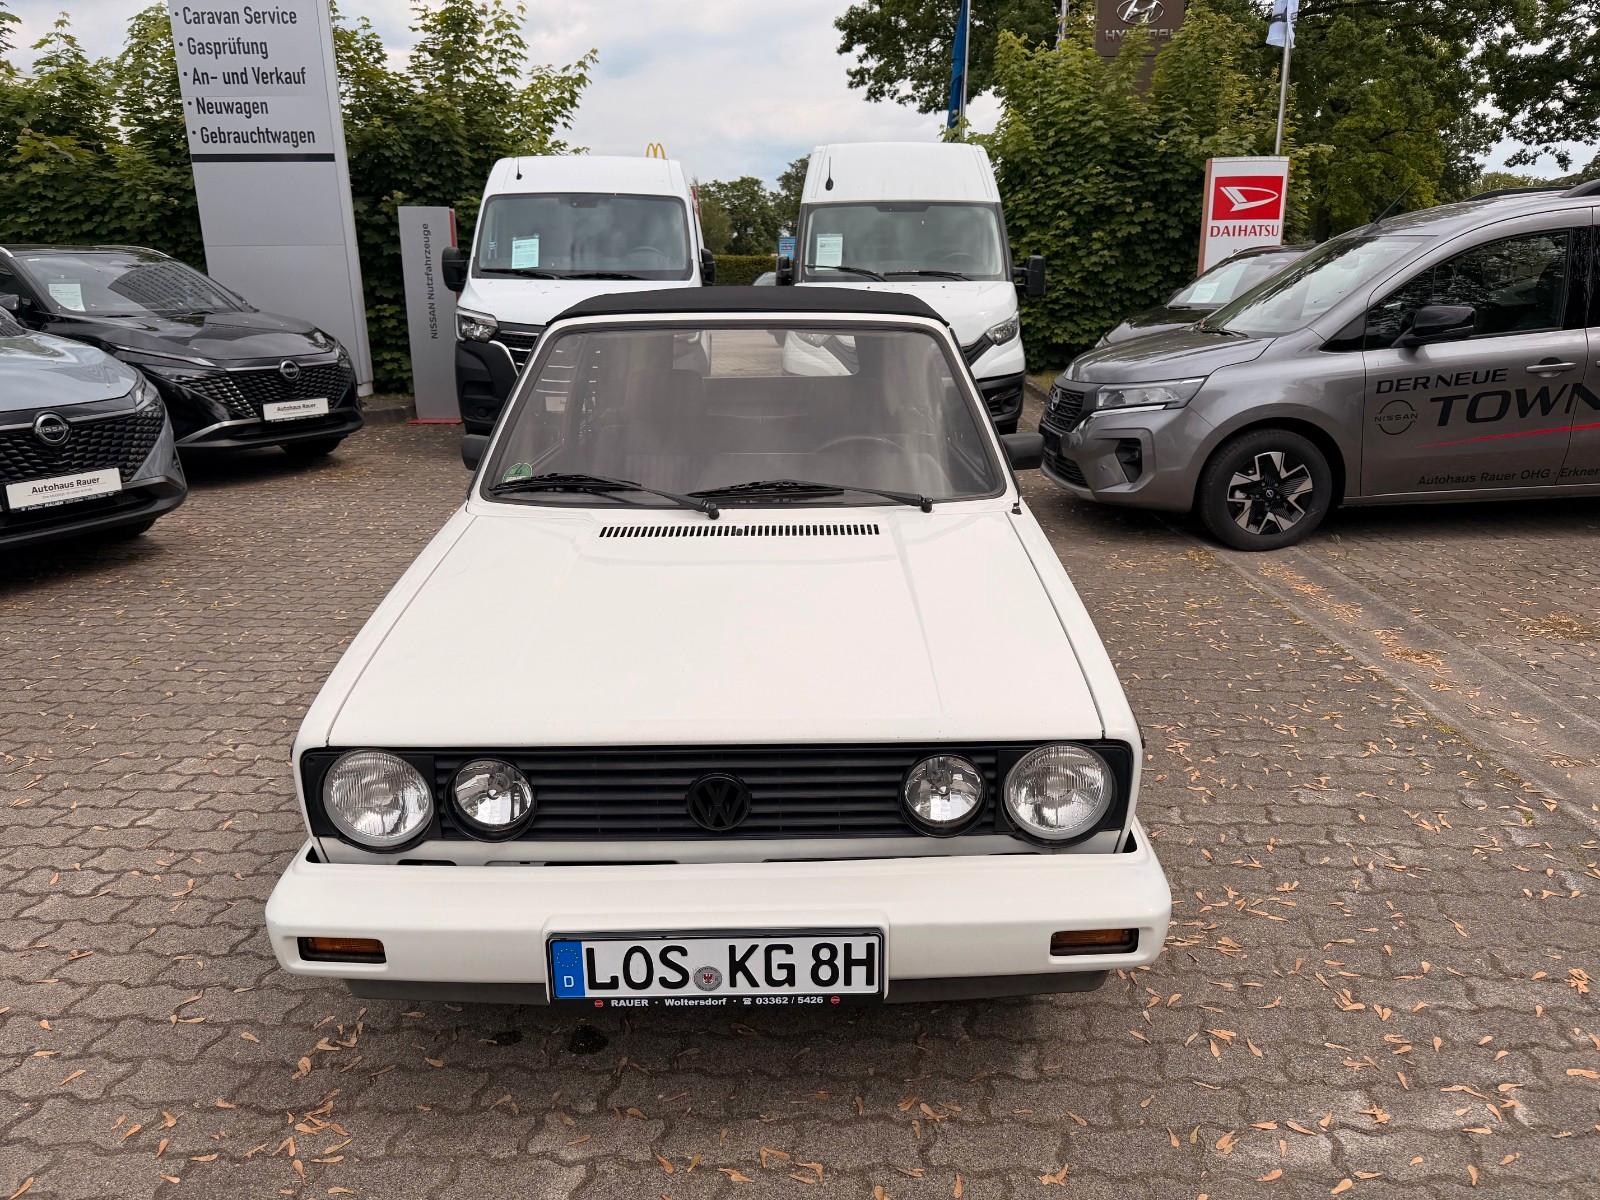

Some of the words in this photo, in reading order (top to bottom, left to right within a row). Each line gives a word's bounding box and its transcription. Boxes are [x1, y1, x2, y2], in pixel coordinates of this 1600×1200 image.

[183, 7, 240, 25] Caravan
[244, 6, 297, 25] Service
[187, 37, 269, 60] Gasprüfung
[192, 67, 218, 86] An-
[223, 67, 249, 85] und
[252, 66, 306, 85] Verkauf
[196, 97, 269, 119] Neuwagen
[200, 126, 316, 149] Gebrauchtwagen
[1210, 224, 1279, 238] DAIHATSU
[422, 223, 436, 300] Nutzfahrzeuge
[427, 303, 439, 340] NISSAN
[1376, 376, 1431, 395] DER
[1435, 368, 1509, 389] NEUE
[1374, 412, 1418, 423] NISSAN
[35, 424, 69, 434] NISSAN
[31, 480, 75, 494] Autohaus
[76, 477, 100, 487] Rauer
[1416, 473, 1476, 486] Autohaus
[1480, 472, 1516, 482] Rauer
[1520, 469, 1551, 480] OHG
[585, 945, 690, 991] LOS
[728, 943, 796, 988] KG
[810, 942, 875, 988] 8H
[563, 975, 575, 988] D
[610, 999, 649, 1007] RAUER
[664, 997, 727, 1007] Woltersdorf
[755, 996, 789, 1005] 03362
[797, 996, 824, 1004] 5426
